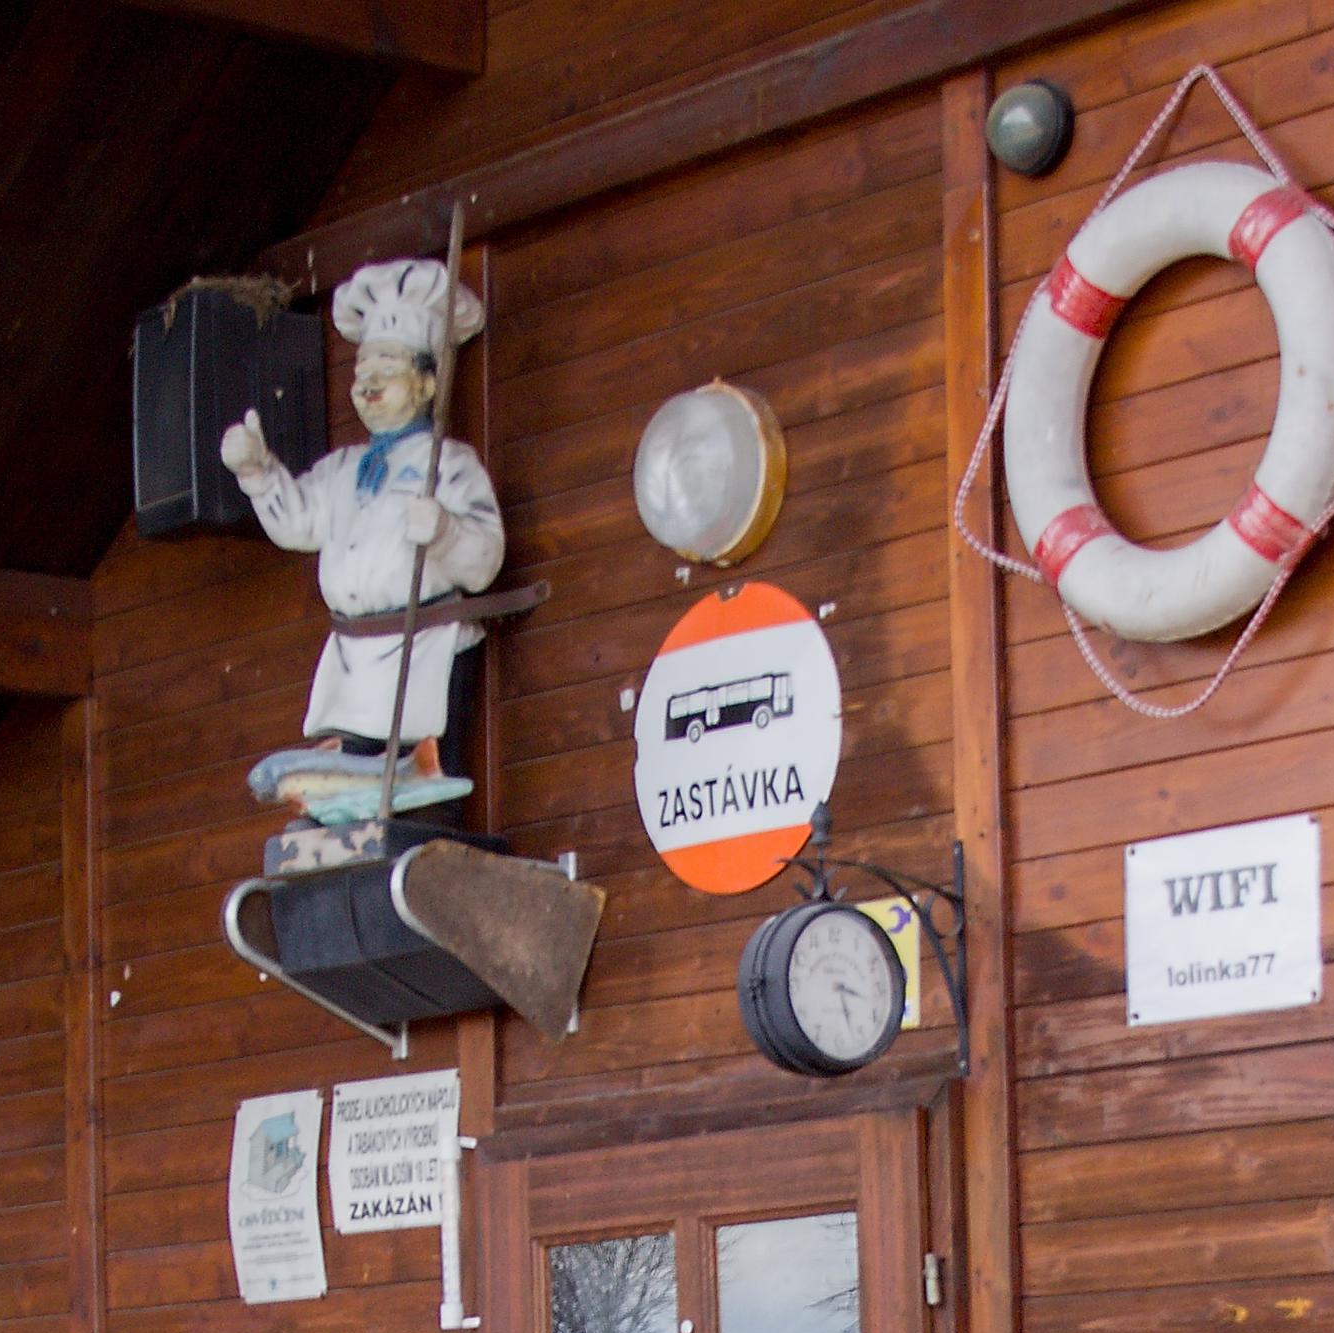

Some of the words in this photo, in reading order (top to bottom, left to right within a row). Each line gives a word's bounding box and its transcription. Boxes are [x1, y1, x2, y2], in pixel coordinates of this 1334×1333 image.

[657, 764, 805, 829] ZASTÁVKA
[1163, 862, 1279, 917] WIFI
[1167, 952, 1276, 988] lolinka77
[349, 1191, 433, 1221] ZAKÁZÁN
